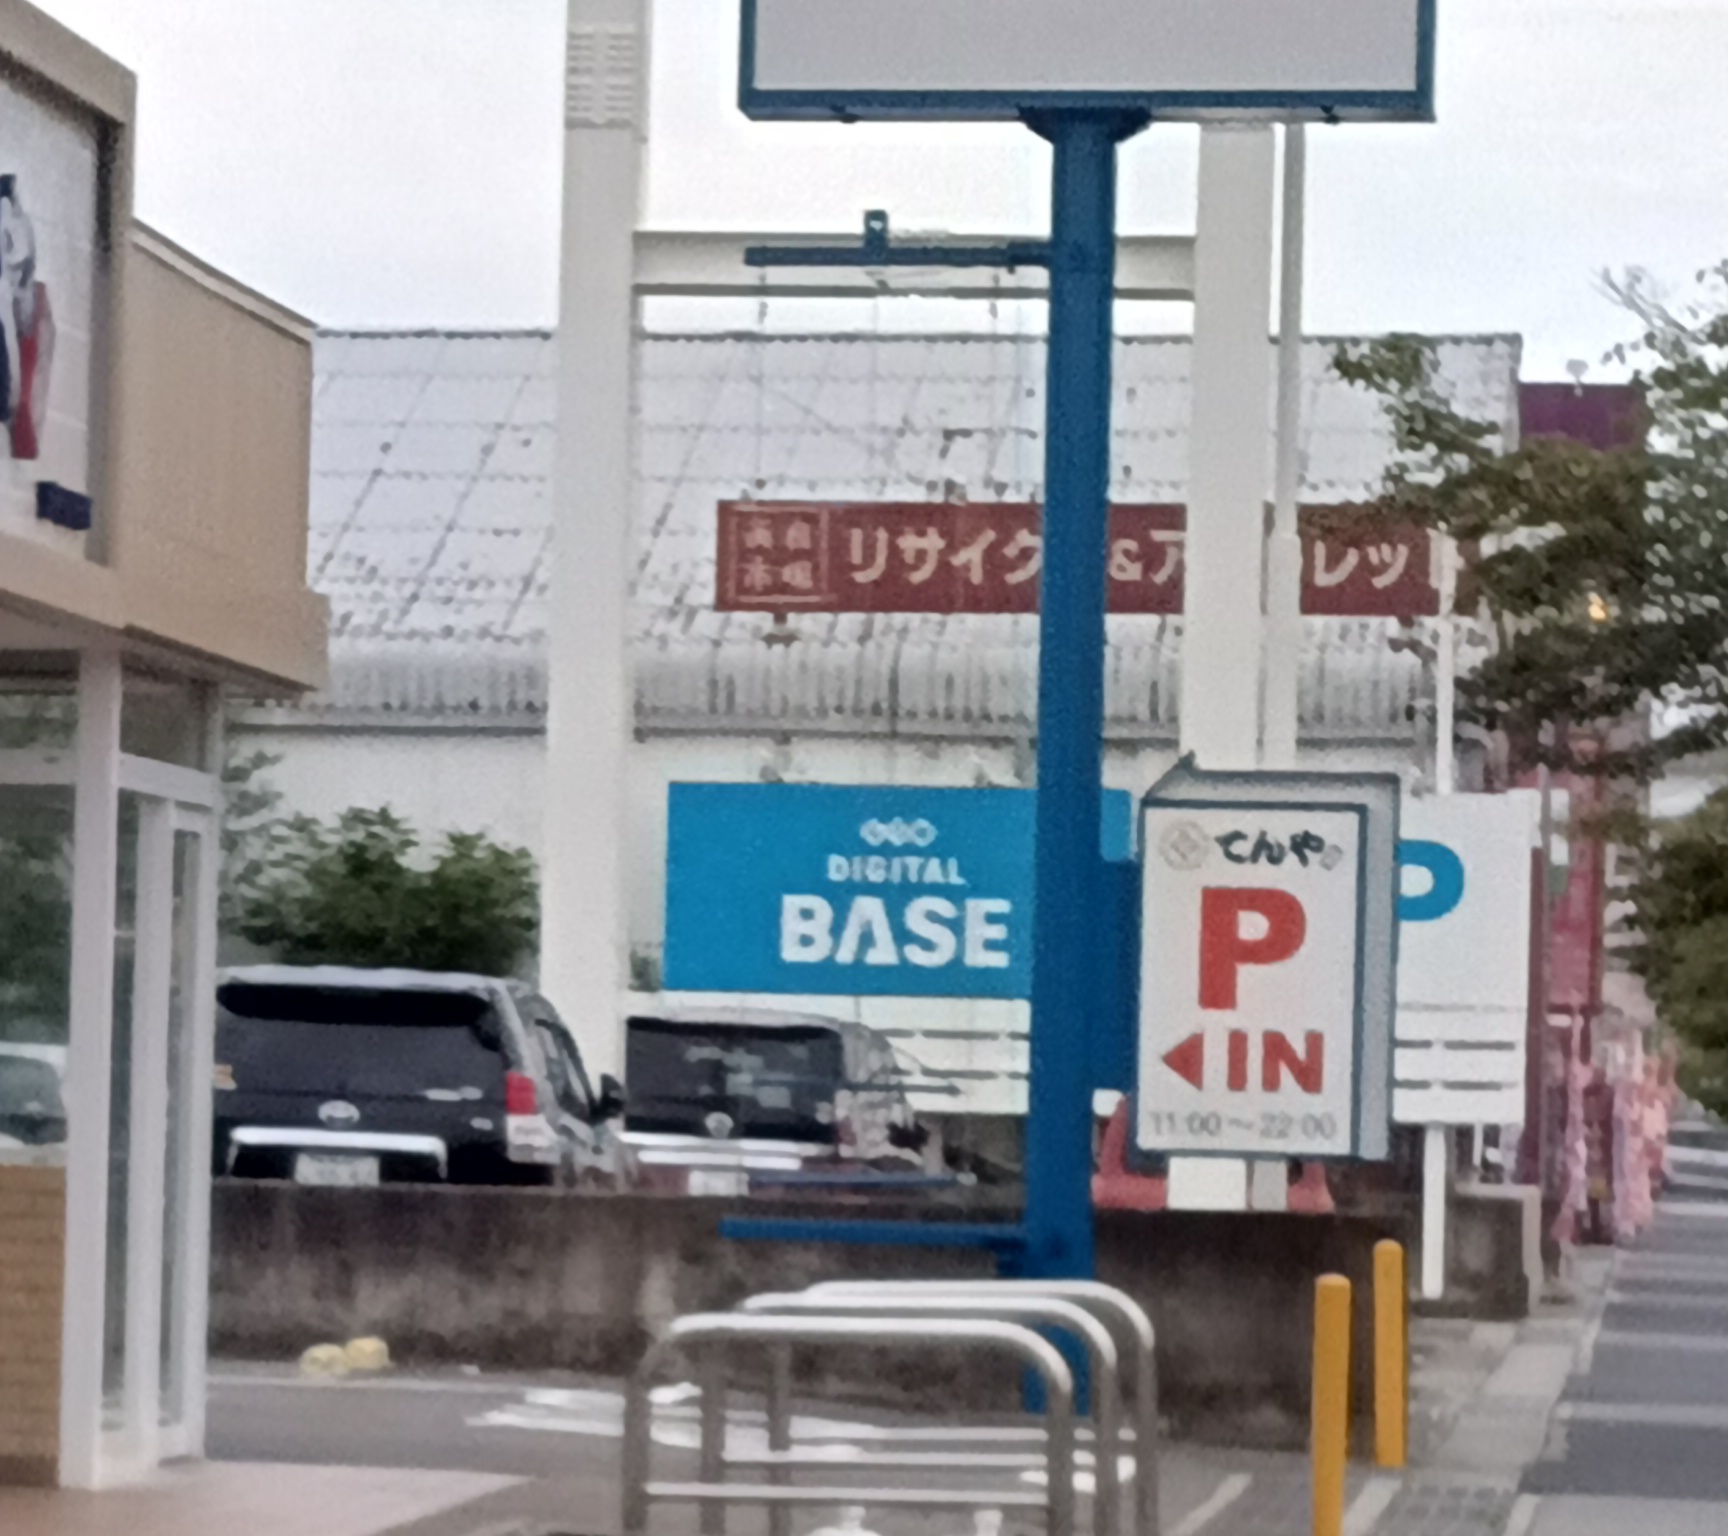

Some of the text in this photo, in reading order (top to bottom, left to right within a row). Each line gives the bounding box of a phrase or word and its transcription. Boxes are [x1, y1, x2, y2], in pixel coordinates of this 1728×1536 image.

[827, 854, 967, 885] DIGITAL
[1214, 829, 1326, 867] てんや
[779, 893, 1012, 969] BASE
[1198, 887, 1307, 1011] P
[1228, 1029, 1325, 1095] IN
[1148, 1110, 1338, 1140] 1100~2200
